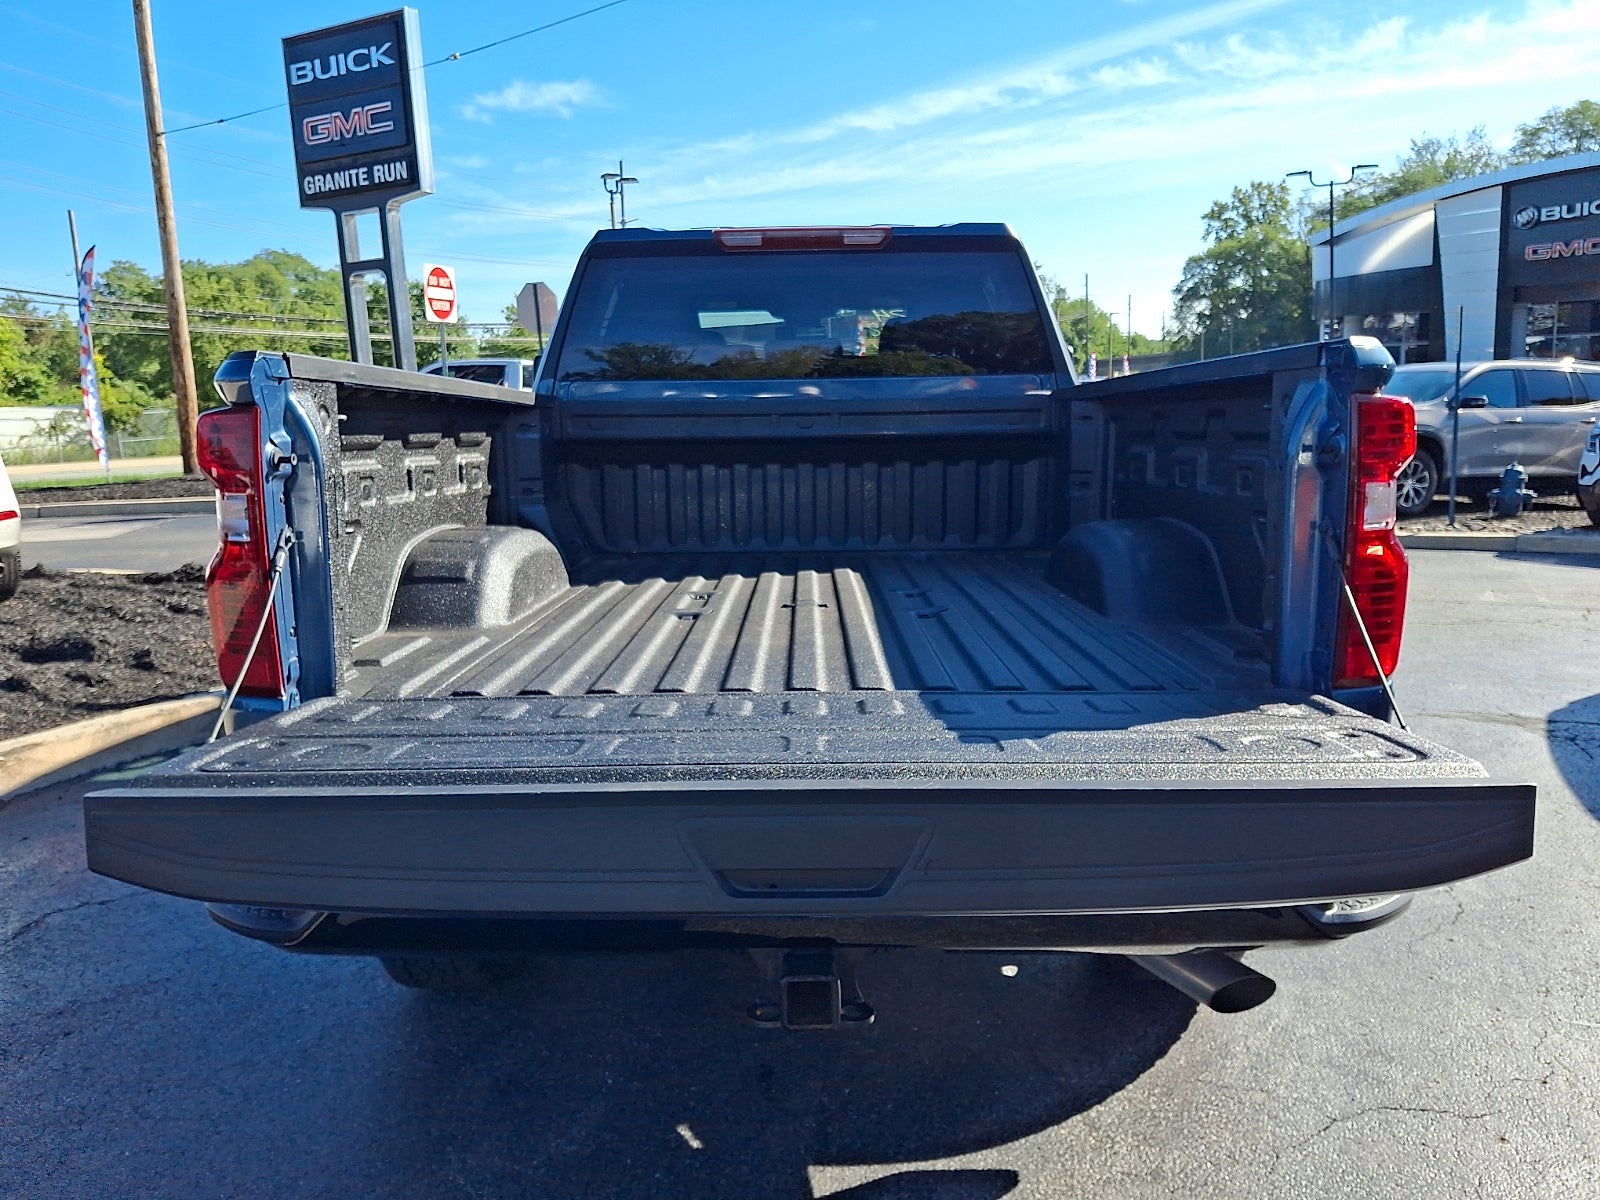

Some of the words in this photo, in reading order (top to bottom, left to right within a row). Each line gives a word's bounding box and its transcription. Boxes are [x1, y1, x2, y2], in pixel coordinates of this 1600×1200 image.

[289, 41, 395, 86] BUICK
[302, 101, 394, 145] GMC
[303, 166, 369, 195] GRANITE
[373, 160, 408, 184] RUN
